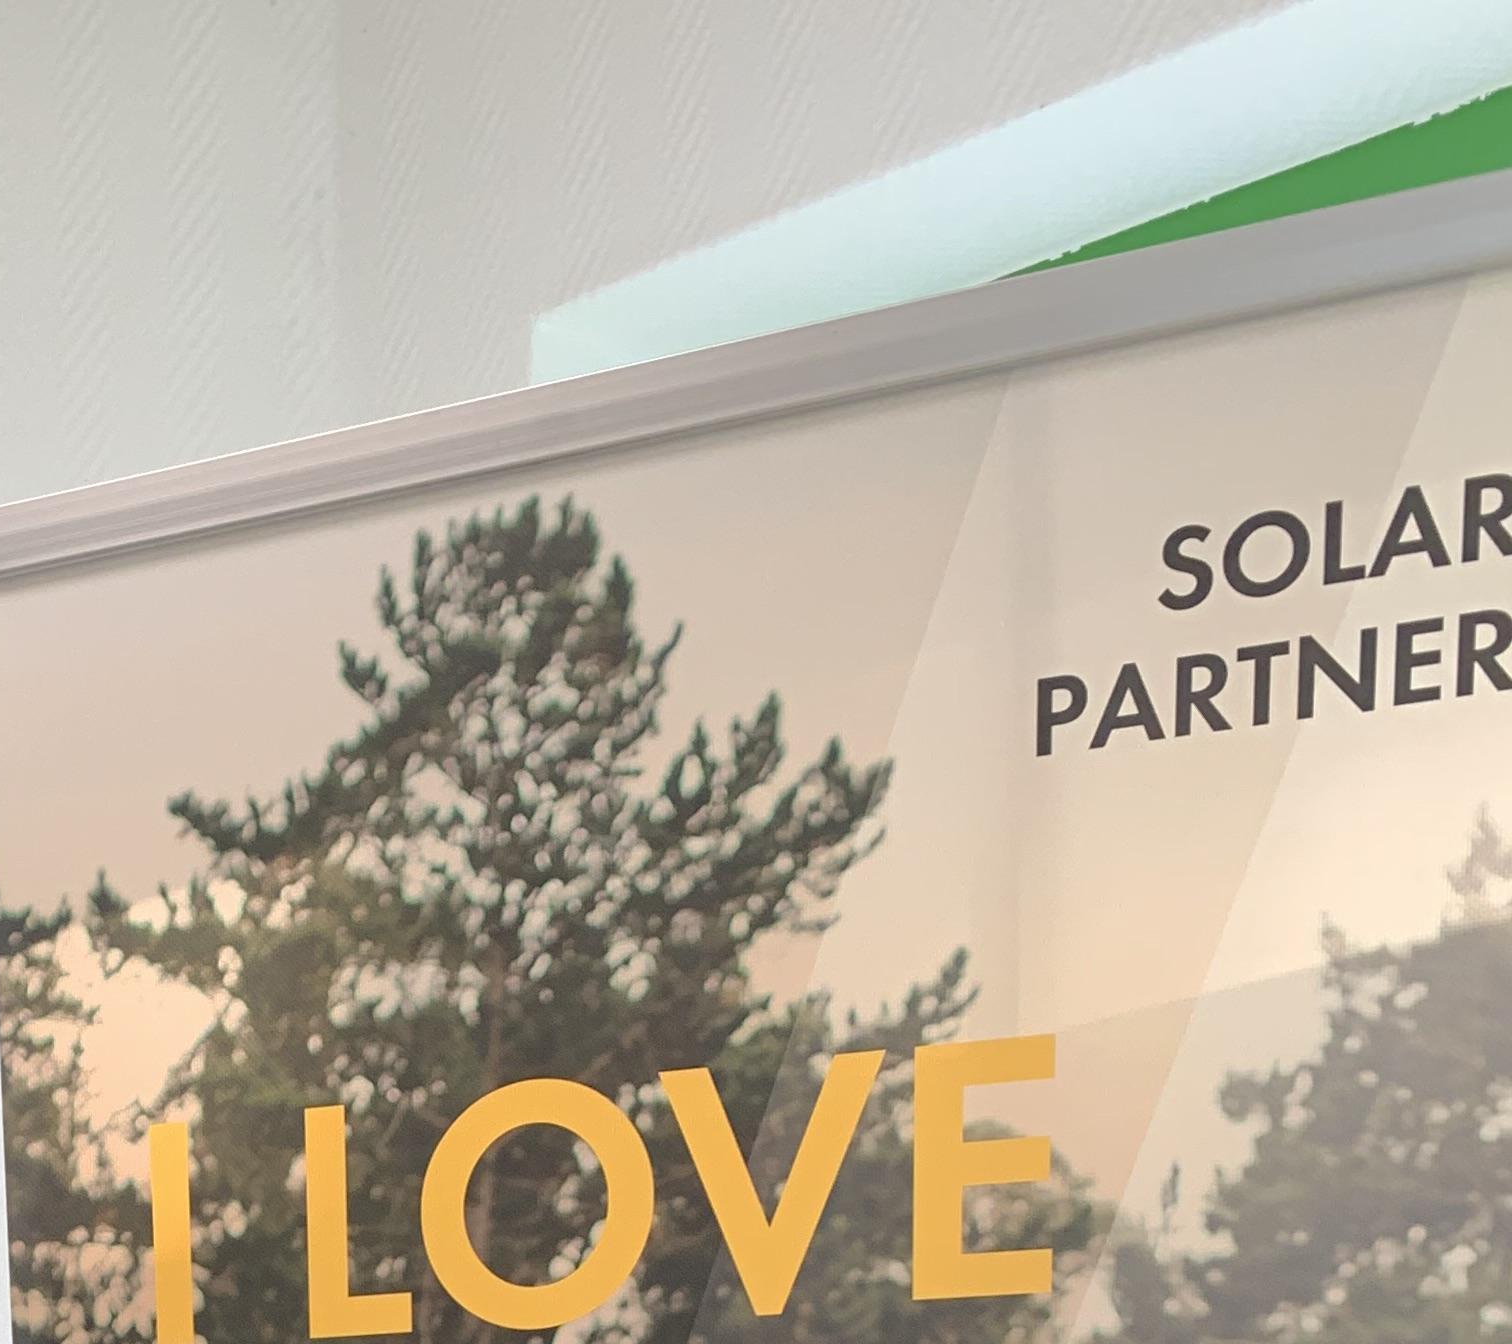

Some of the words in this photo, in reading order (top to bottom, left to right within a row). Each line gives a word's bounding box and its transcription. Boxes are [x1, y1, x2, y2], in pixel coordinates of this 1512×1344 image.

[1157, 473, 1512, 611] SOLAR
[1035, 609, 1512, 757] PARTNER
[303, 1033, 1057, 1340] LOVE
